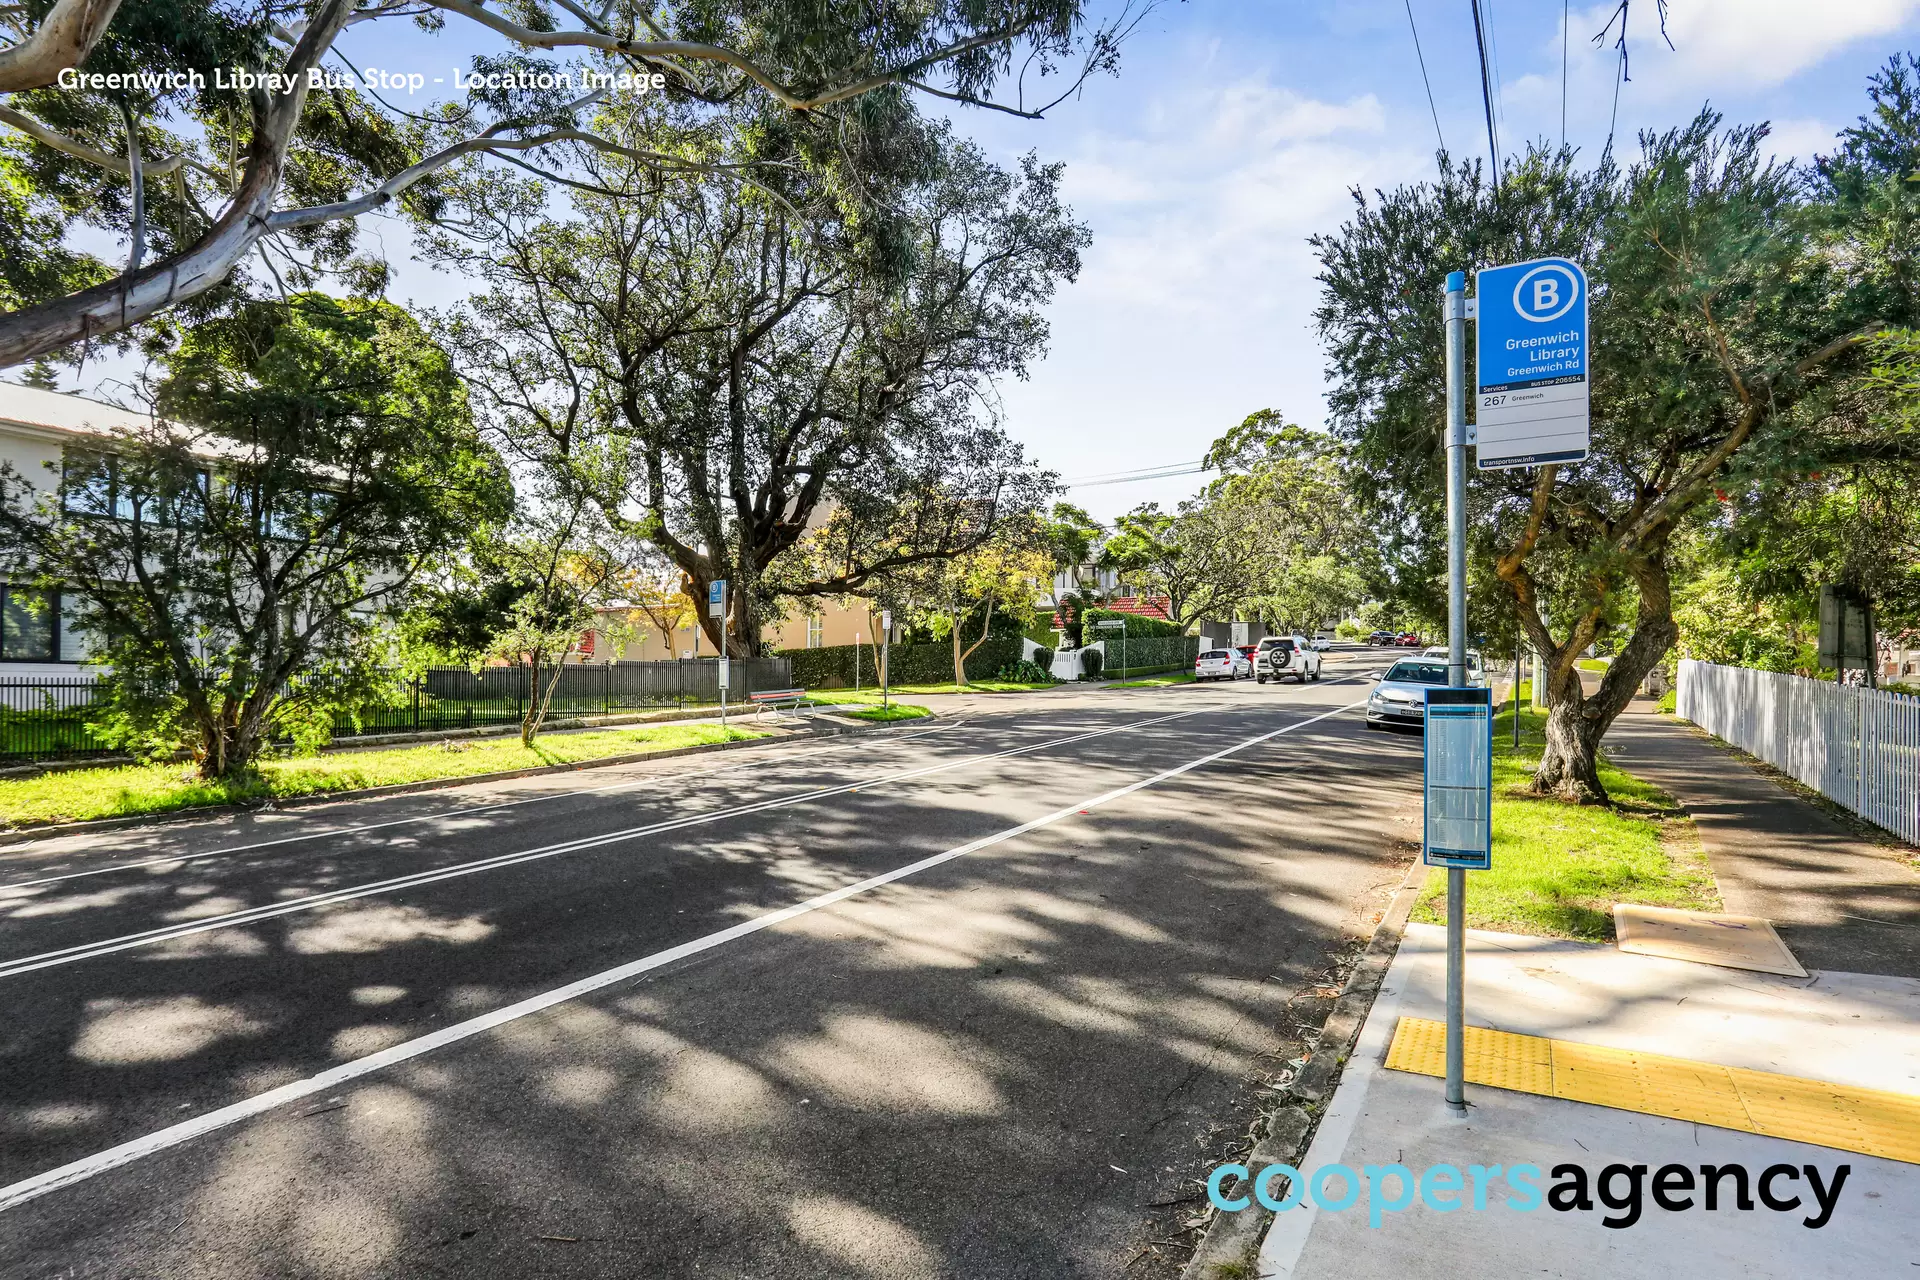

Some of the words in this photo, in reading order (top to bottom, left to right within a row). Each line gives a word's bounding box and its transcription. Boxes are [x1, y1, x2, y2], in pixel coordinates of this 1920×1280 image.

[1533, 278, 1559, 311] B
[1506, 330, 1579, 350] Greenwich
[1530, 346, 1580, 362] Library
[1507, 363, 1563, 377] Greenwich
[1565, 359, 1580, 369] Rd
[1483, 385, 1508, 393] Services
[1484, 395, 1507, 407] 267
[1511, 393, 1544, 402] Greenwich
[1483, 456, 1535, 466] transportnsw.info
